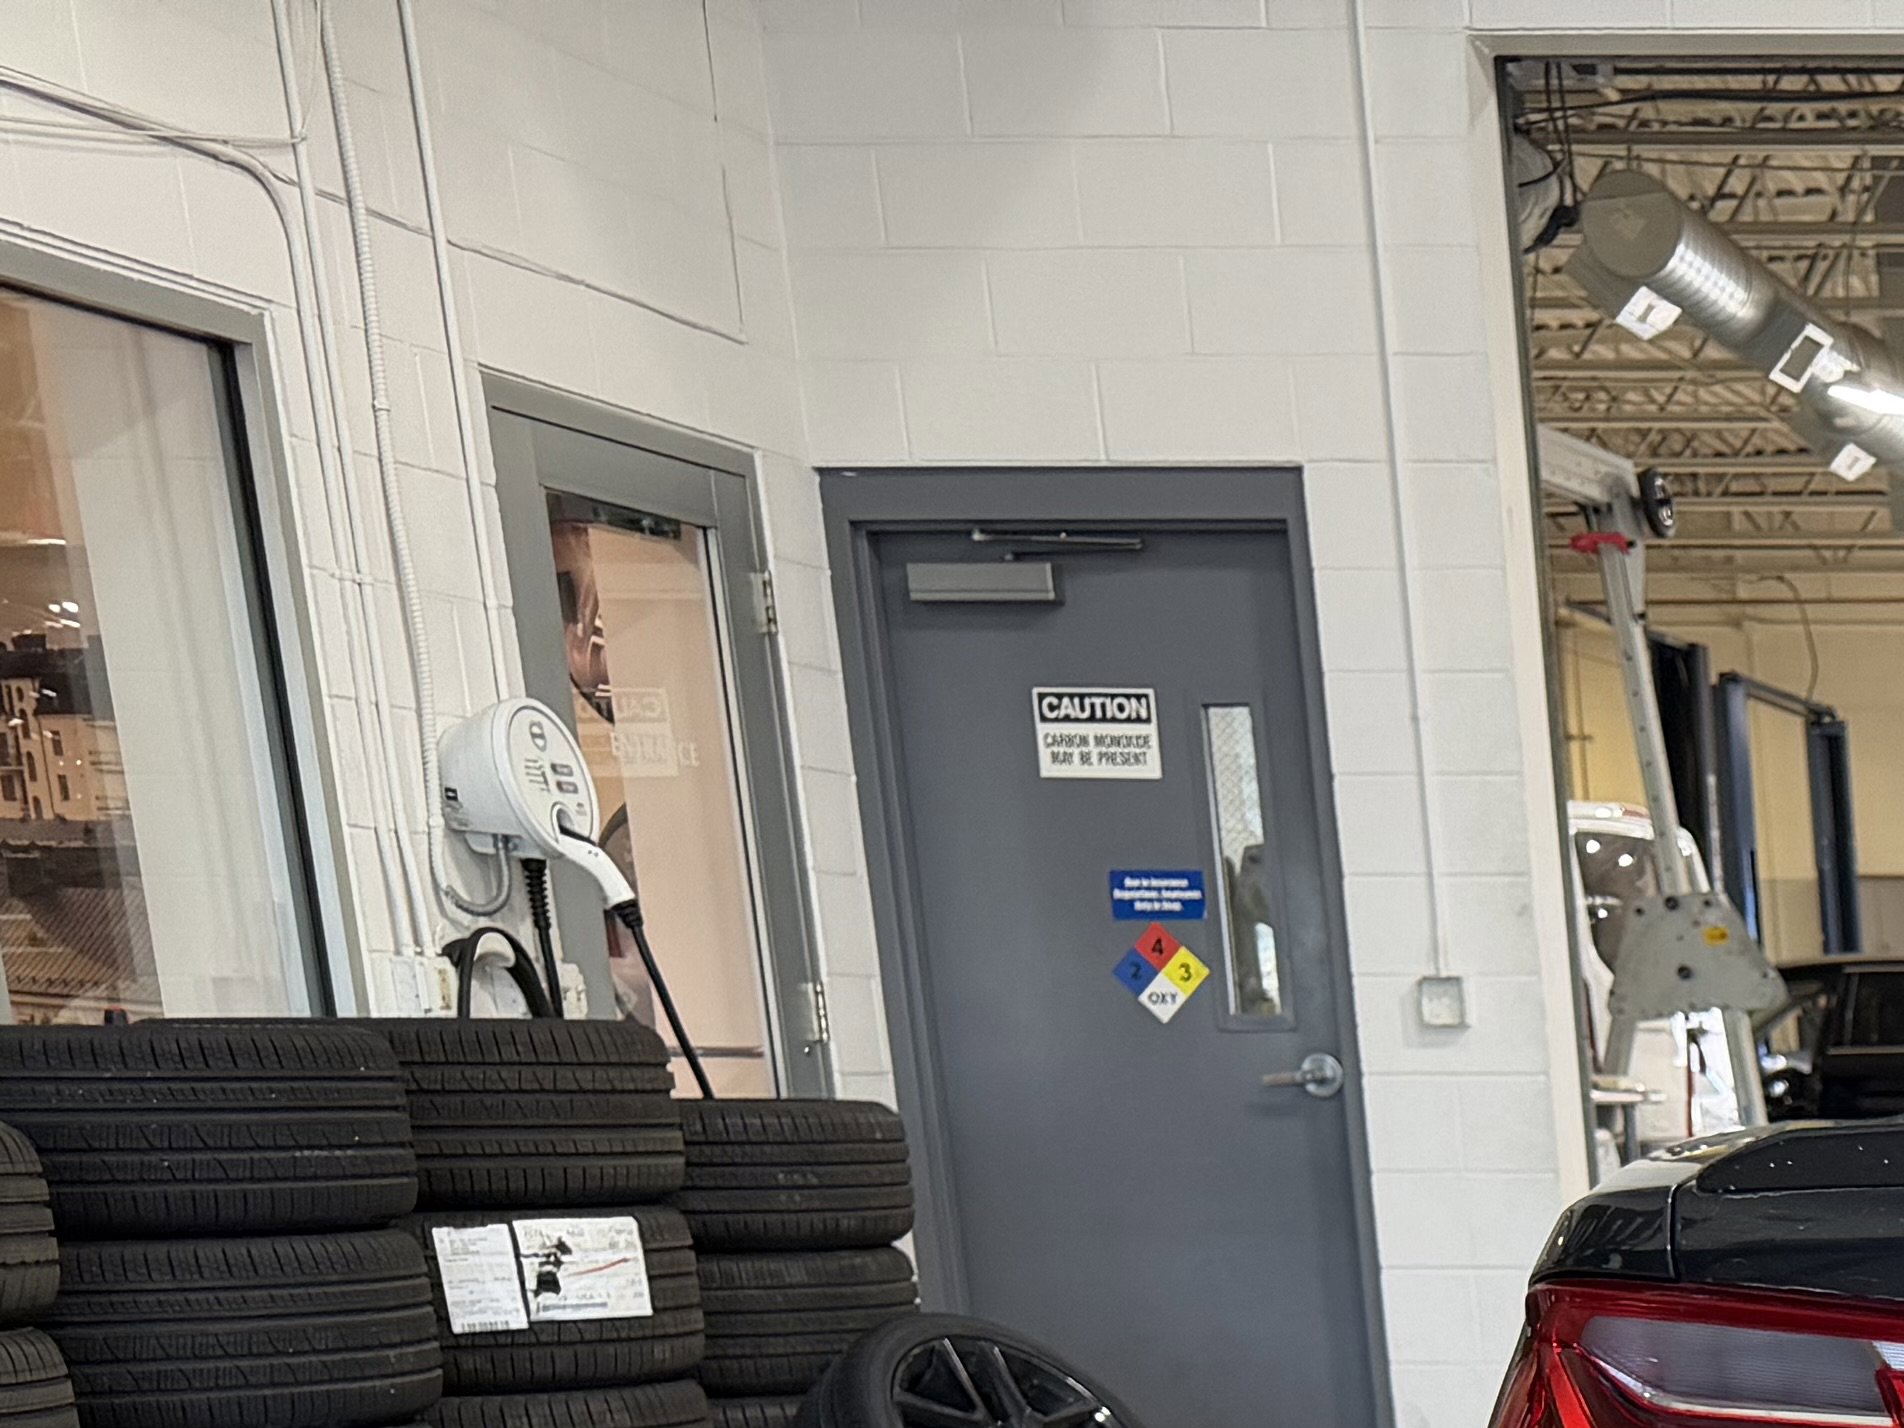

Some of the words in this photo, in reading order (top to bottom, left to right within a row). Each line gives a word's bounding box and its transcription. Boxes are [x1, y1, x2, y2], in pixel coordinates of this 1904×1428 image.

[1041, 696, 1148, 720] CAUTION
[1151, 937, 1164, 956] 4
[1130, 961, 1143, 981] 2
[1178, 962, 1192, 983] 3
[1148, 992, 1178, 1005] OXY
